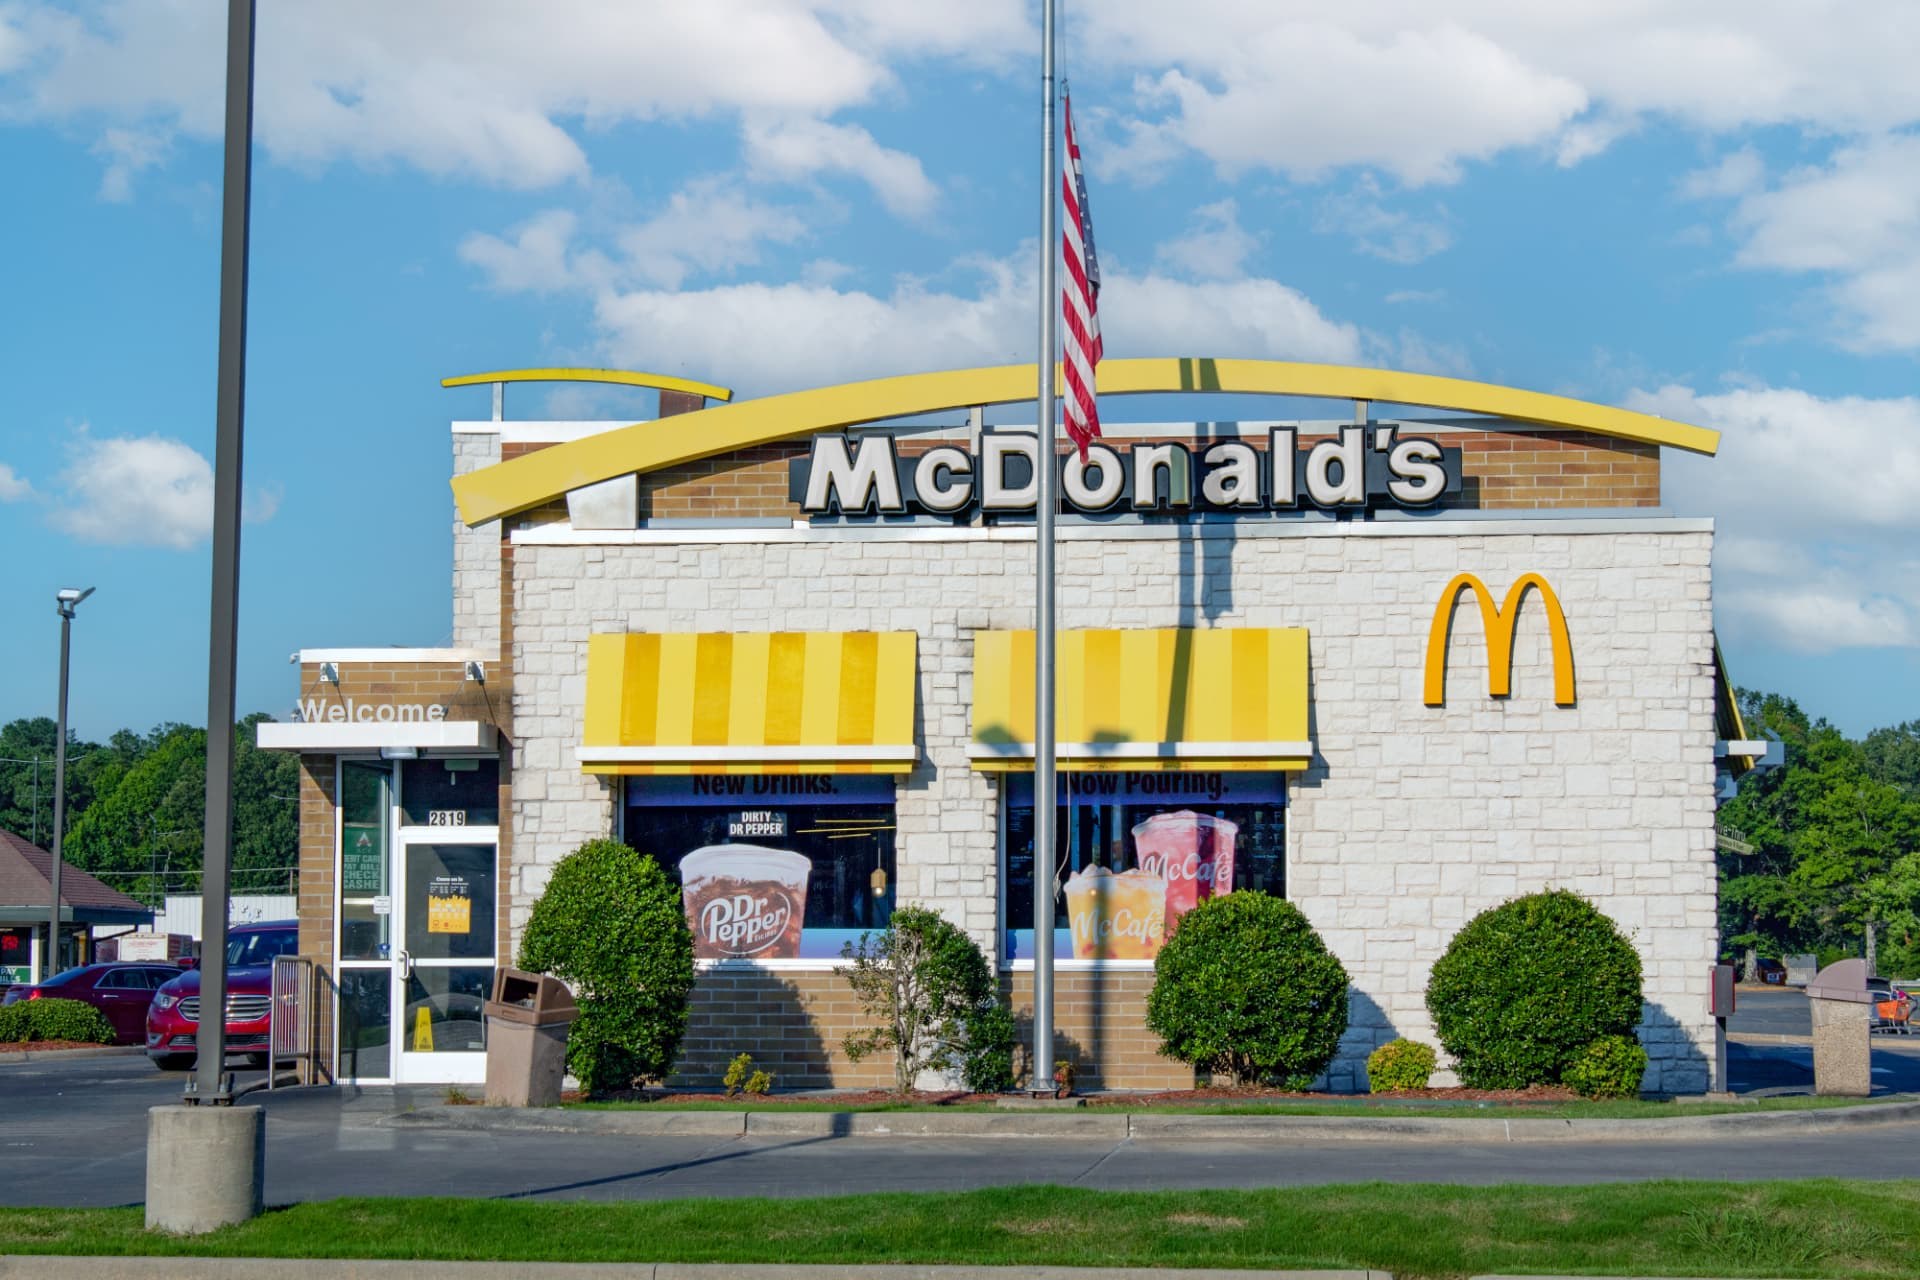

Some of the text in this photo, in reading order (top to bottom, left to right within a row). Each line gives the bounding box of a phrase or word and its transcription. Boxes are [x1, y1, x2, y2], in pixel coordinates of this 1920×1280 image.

[803, 426, 1448, 512] McDonald's
[296, 698, 445, 723] Welcome
[693, 774, 838, 795] New Drinks.
[1064, 771, 1229, 800] Now Pouring.
[430, 811, 464, 826] 2819
[741, 811, 771, 822] DIRTY
[729, 823, 782, 835] DR PEPPER
[344, 871, 379, 880] CHECK
[344, 880, 379, 889] CASHE
[732, 895, 768, 922] Dr
[702, 898, 786, 947] Pepper
